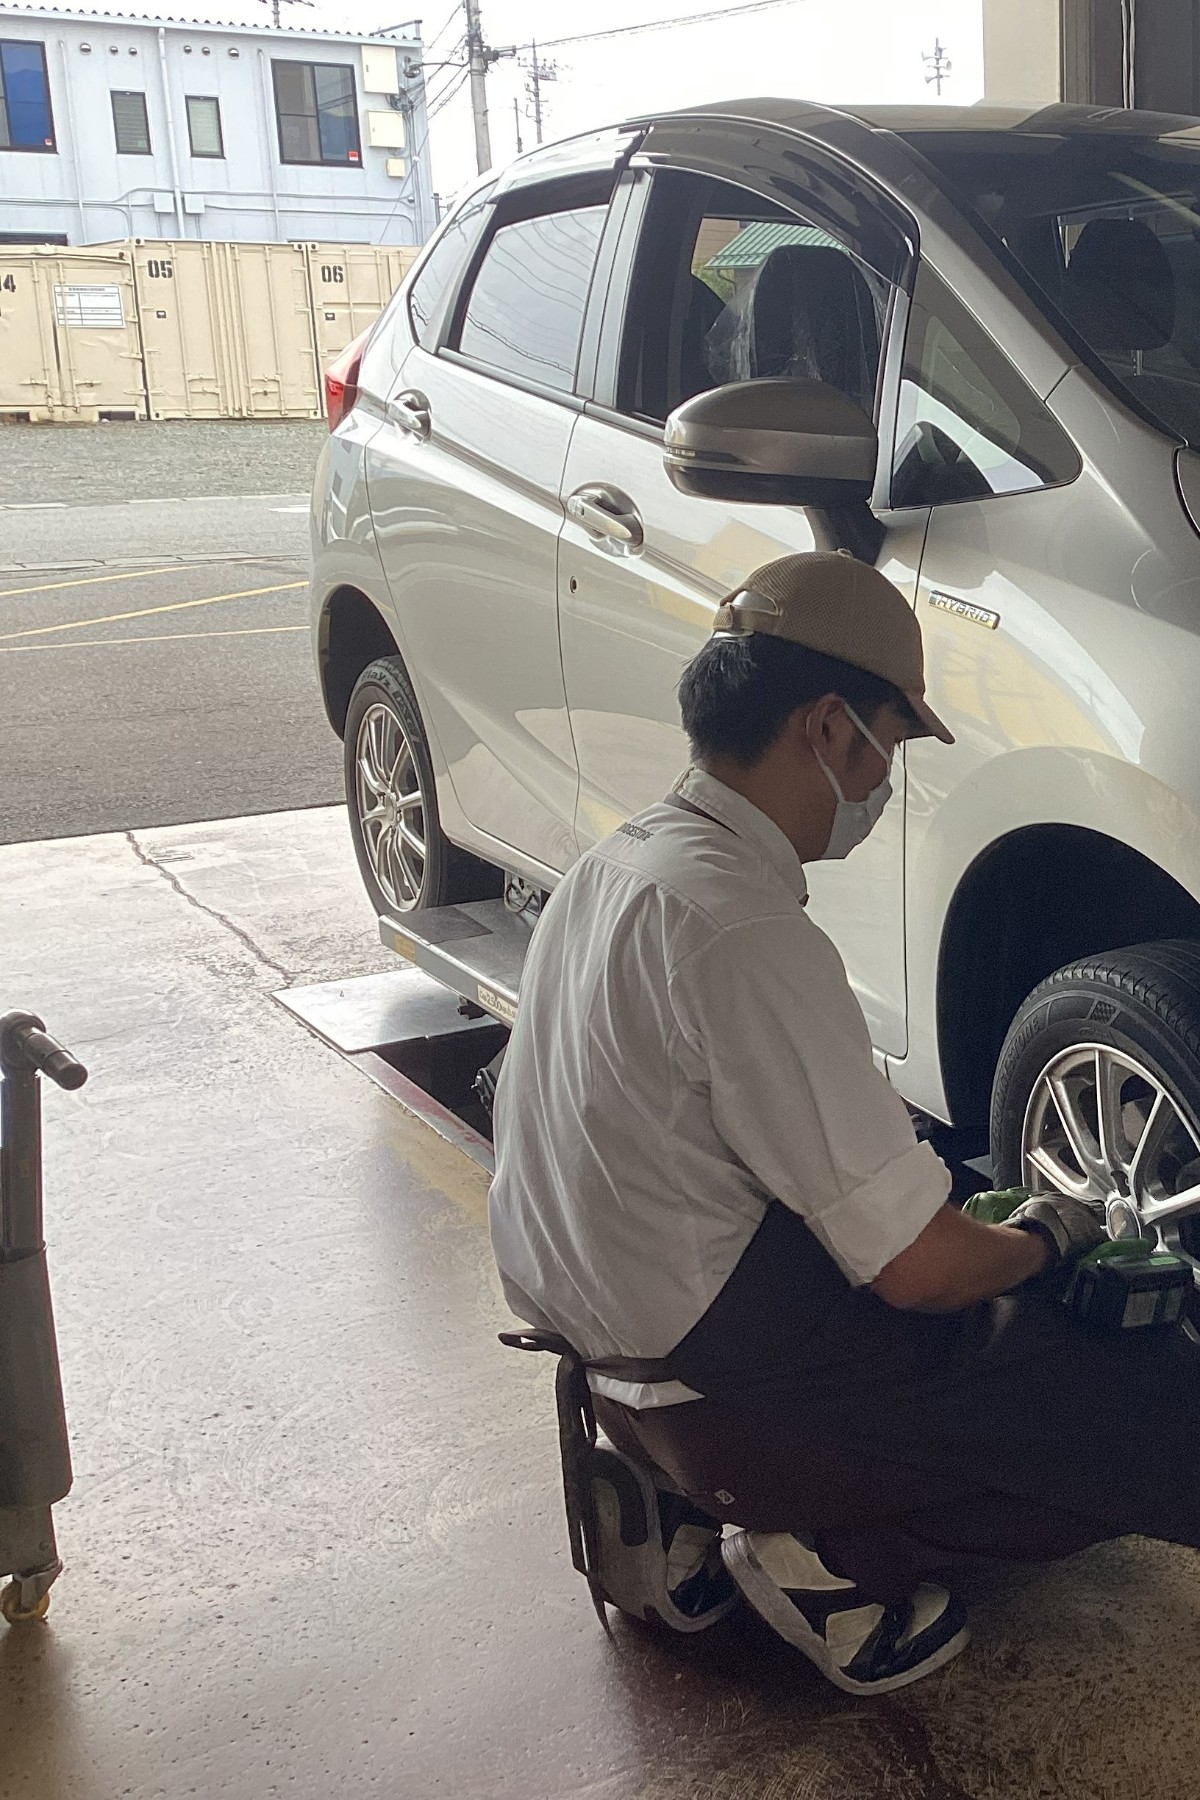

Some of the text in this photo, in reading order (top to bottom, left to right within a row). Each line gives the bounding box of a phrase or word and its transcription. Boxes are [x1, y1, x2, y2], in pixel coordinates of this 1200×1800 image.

[147, 260, 173, 279] 05
[321, 265, 344, 284] 06
[0, 274, 17, 293] 4
[936, 596, 991, 623] HYBRID
